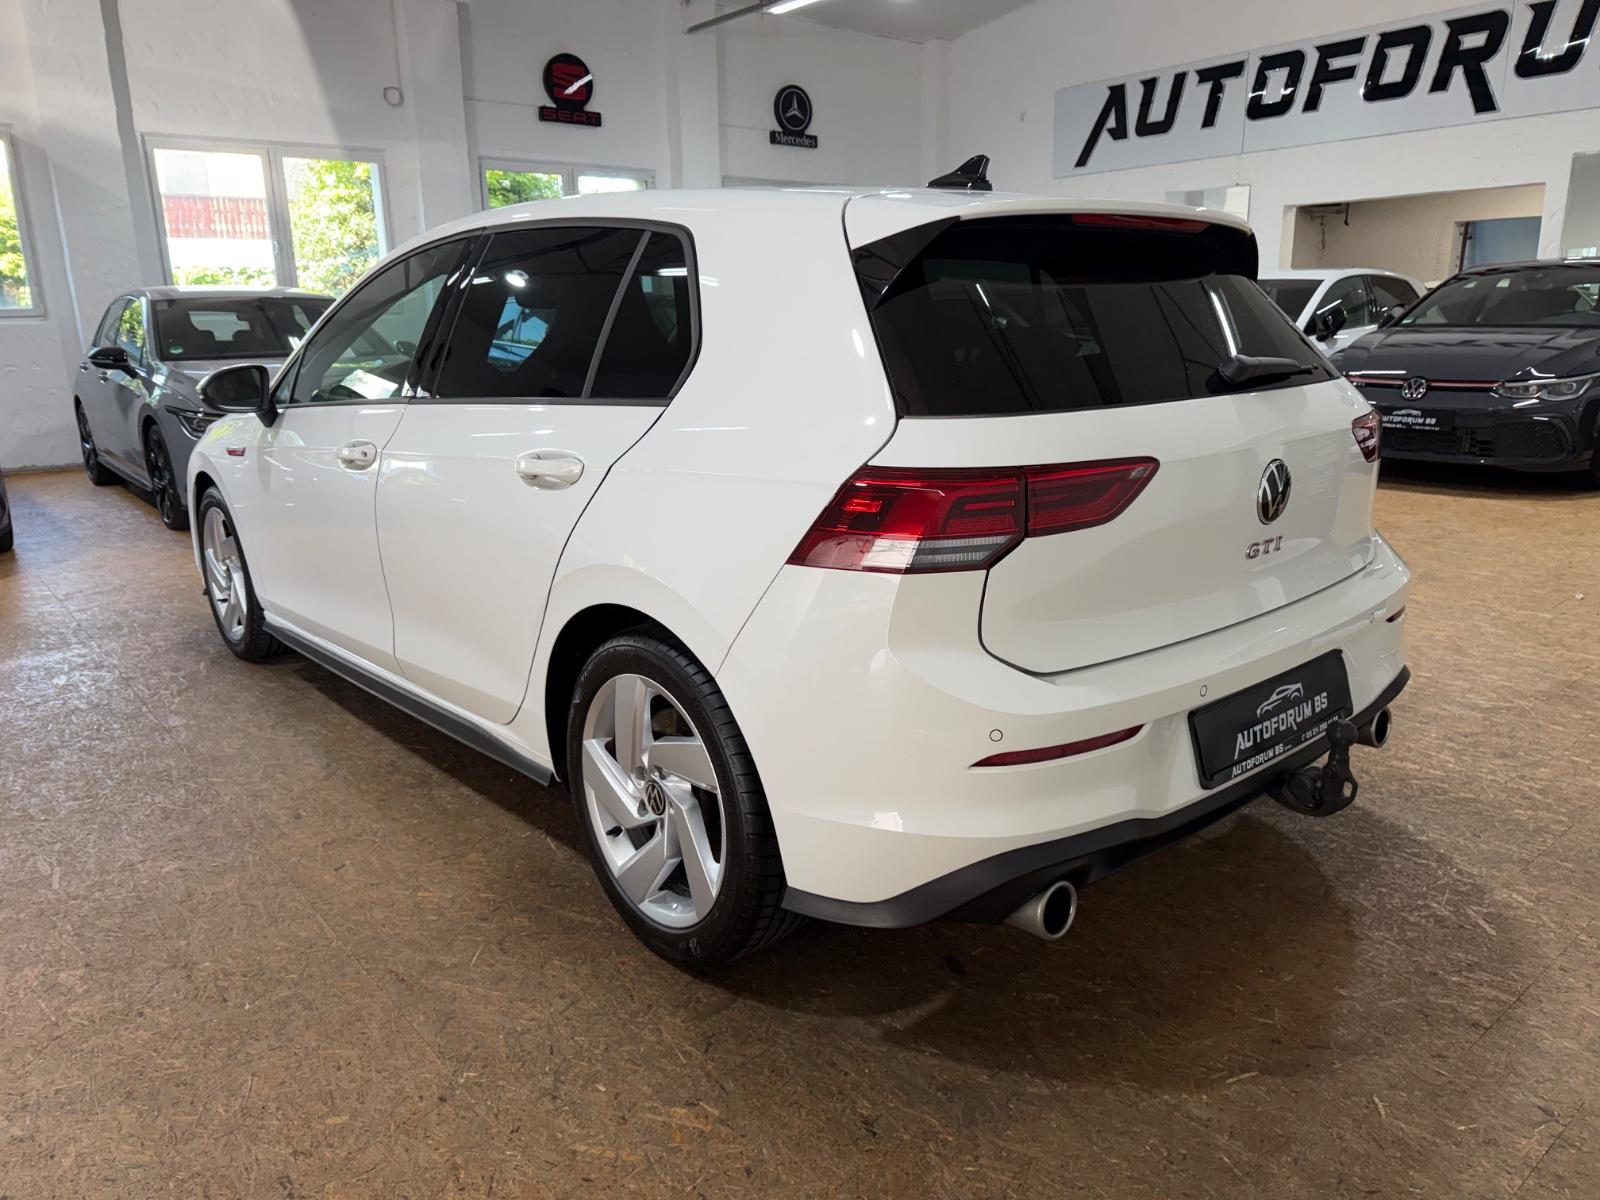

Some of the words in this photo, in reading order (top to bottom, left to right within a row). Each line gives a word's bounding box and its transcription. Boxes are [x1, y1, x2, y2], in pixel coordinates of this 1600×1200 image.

[1073, 0, 1600, 168] AUTOFORU
[543, 107, 600, 127] SEAT
[775, 132, 816, 147] Mercedes
[1382, 415, 1424, 425] UTOFORUM
[1246, 536, 1283, 559] GTI
[1234, 699, 1312, 760] AUTOFORUM
[1231, 747, 1274, 779] AUTOFORUM
